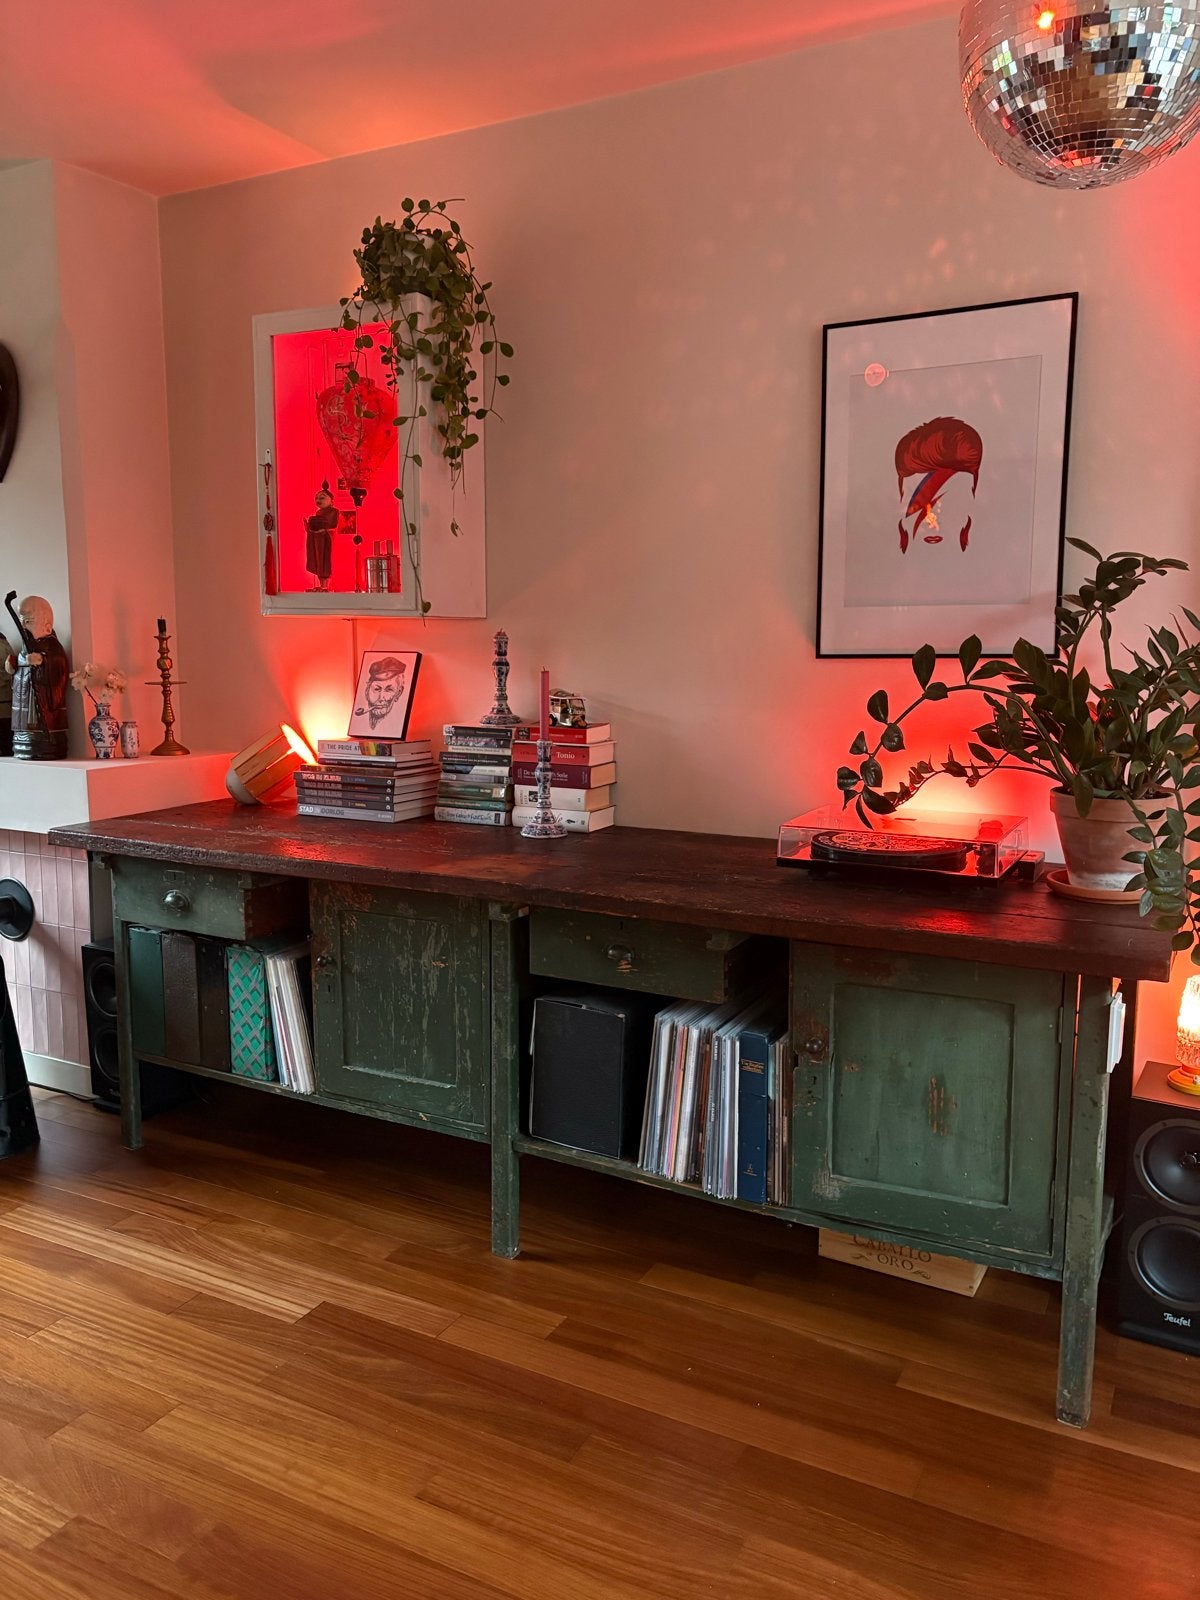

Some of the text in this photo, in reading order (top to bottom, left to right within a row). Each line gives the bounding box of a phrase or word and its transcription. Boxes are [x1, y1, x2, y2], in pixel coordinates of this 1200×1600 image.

[556, 751, 575, 759] Tonio
[299, 805, 314, 813] STAD
[877, 1253, 914, 1270] ORO
[1163, 1312, 1191, 1327] Teufel
